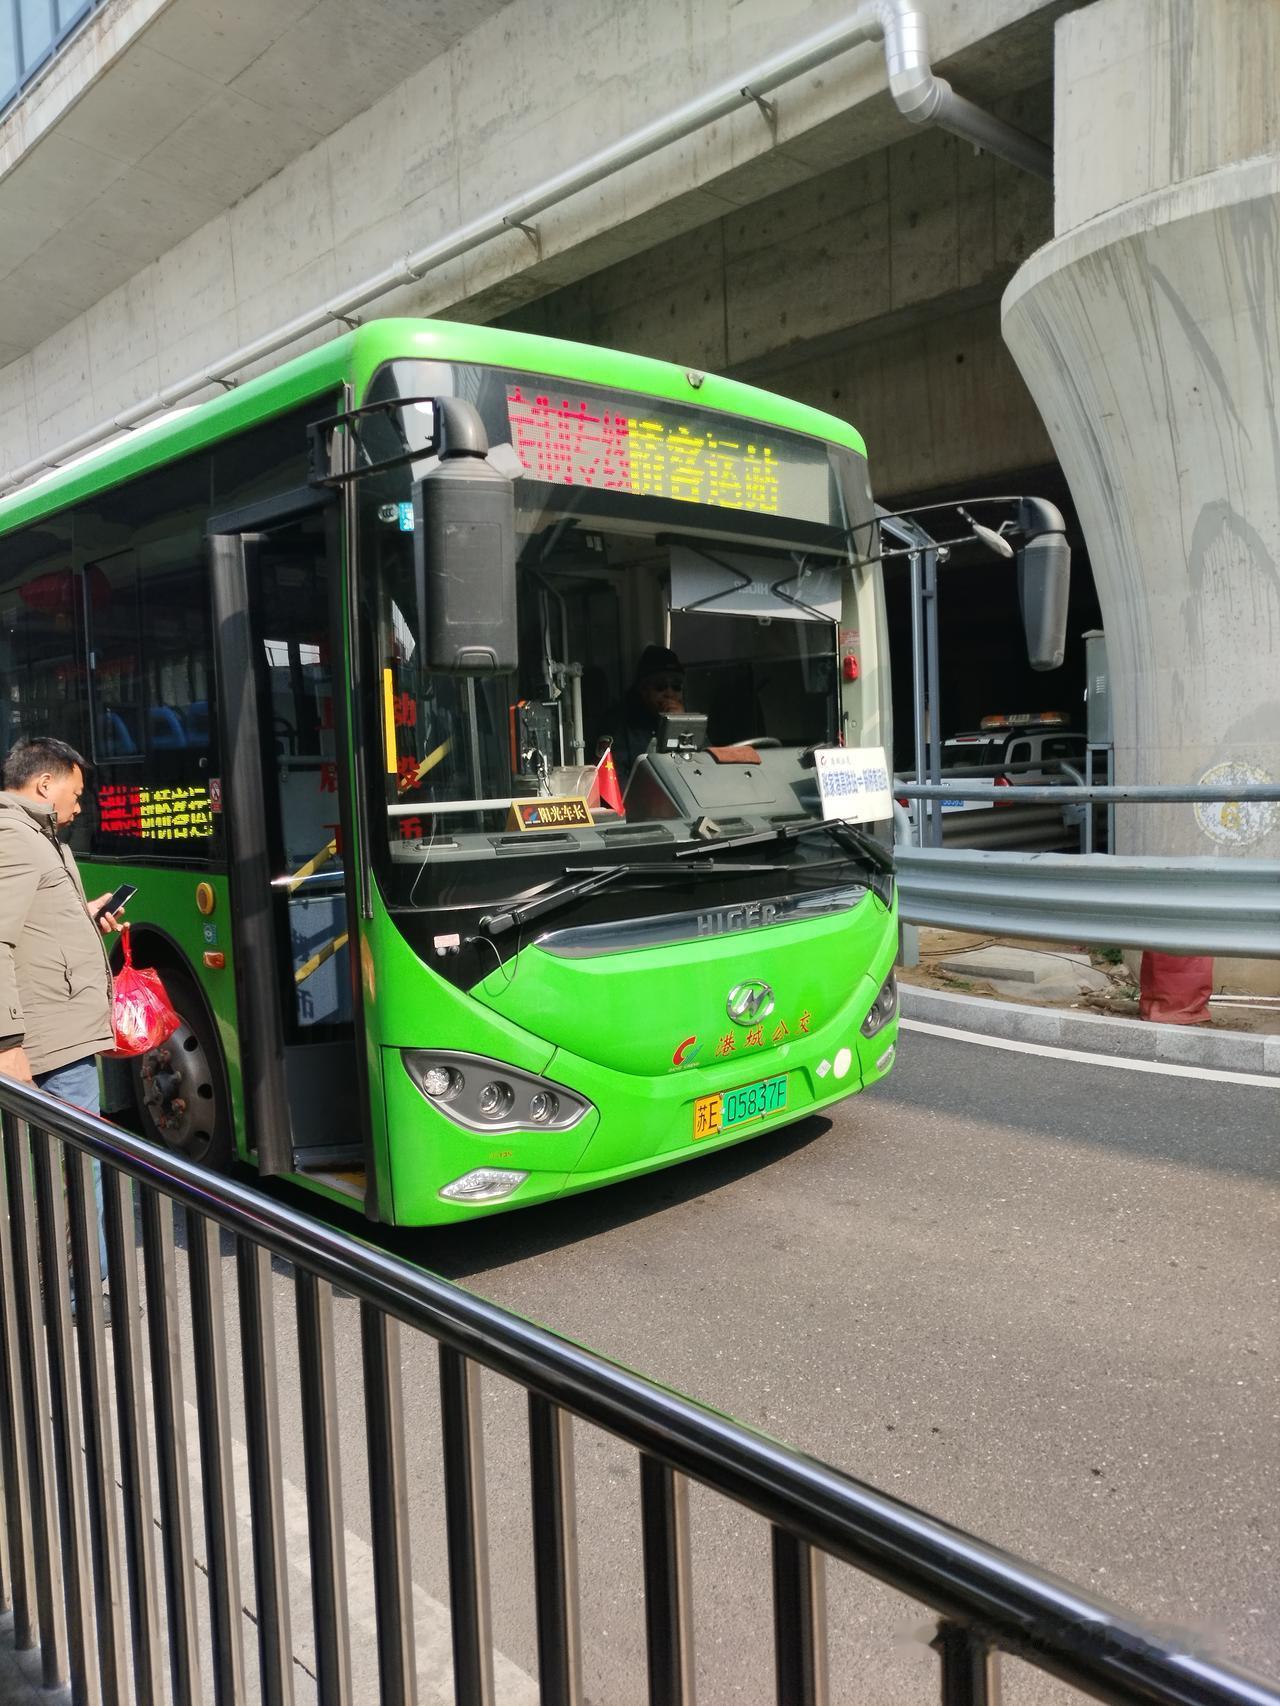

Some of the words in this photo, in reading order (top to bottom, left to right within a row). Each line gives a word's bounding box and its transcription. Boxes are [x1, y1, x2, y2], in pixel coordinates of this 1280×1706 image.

[537, 804, 587, 824] 阳光车长
[696, 904, 777, 937] HIGER
[715, 1009, 812, 1057] 港城公交
